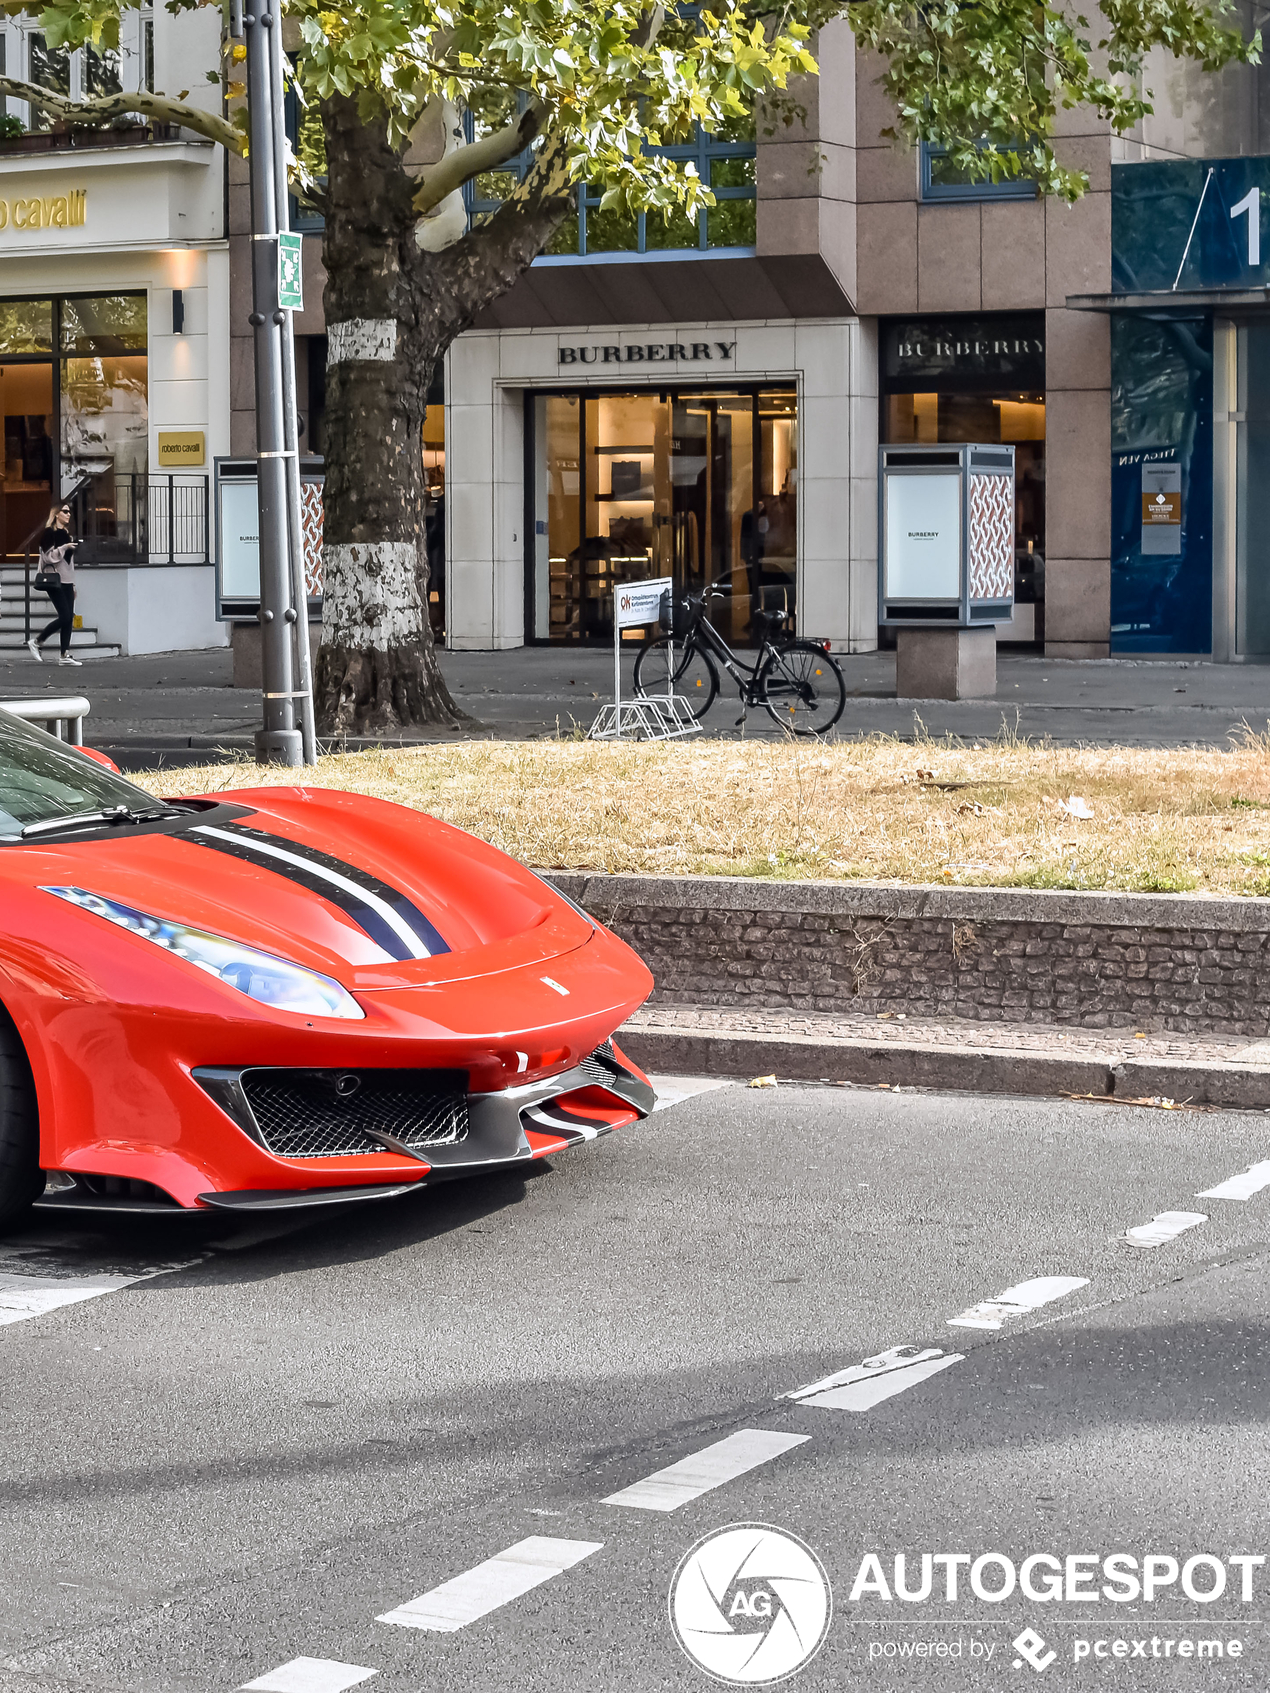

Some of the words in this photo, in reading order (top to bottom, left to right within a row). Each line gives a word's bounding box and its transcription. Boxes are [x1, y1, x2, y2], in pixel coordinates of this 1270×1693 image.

[12, 189, 87, 229] cavalli
[1230, 187, 1260, 266] 1
[558, 341, 737, 364] BURBERRY
[898, 339, 1044, 357] BURBERRY
[161, 443, 181, 453] roberto
[182, 443, 200, 452] cavalli
